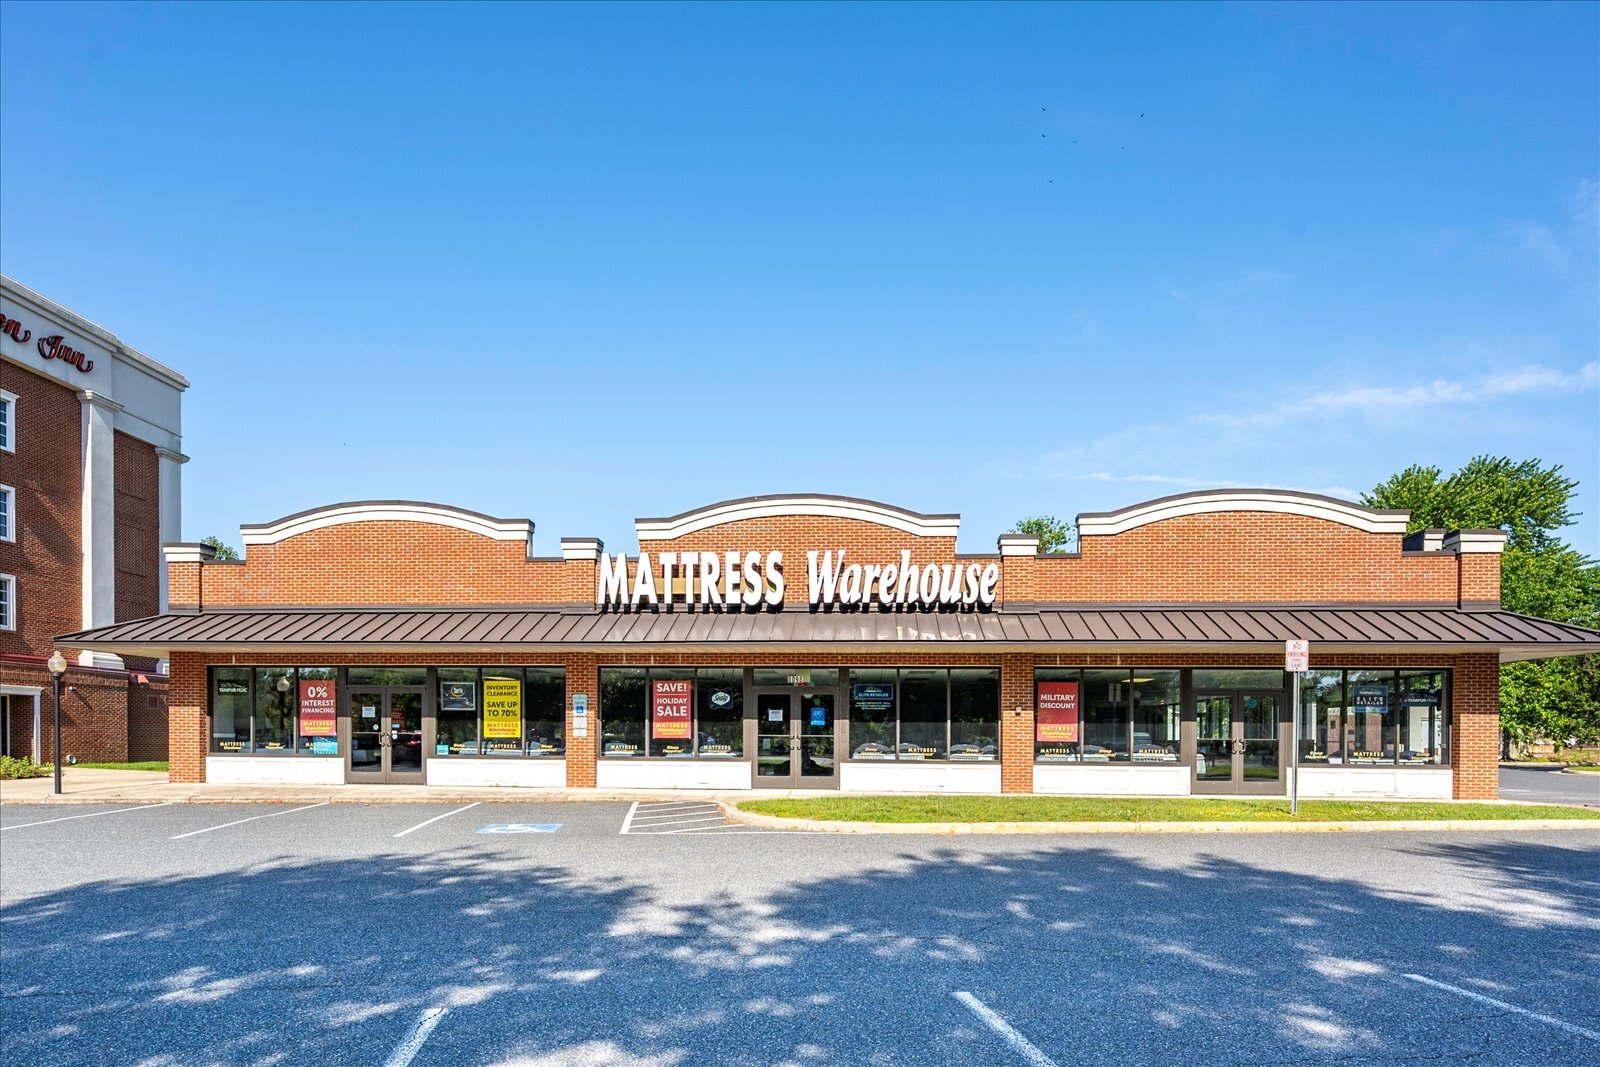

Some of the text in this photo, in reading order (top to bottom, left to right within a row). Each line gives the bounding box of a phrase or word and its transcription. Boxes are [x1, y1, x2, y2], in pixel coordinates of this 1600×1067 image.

[37, 335, 94, 373] Inn
[599, 550, 999, 606] MATTRESS Warehouse
[307, 686, 328, 698] 0%
[656, 683, 687, 692] SAVE!
[656, 706, 688, 716] SALE
